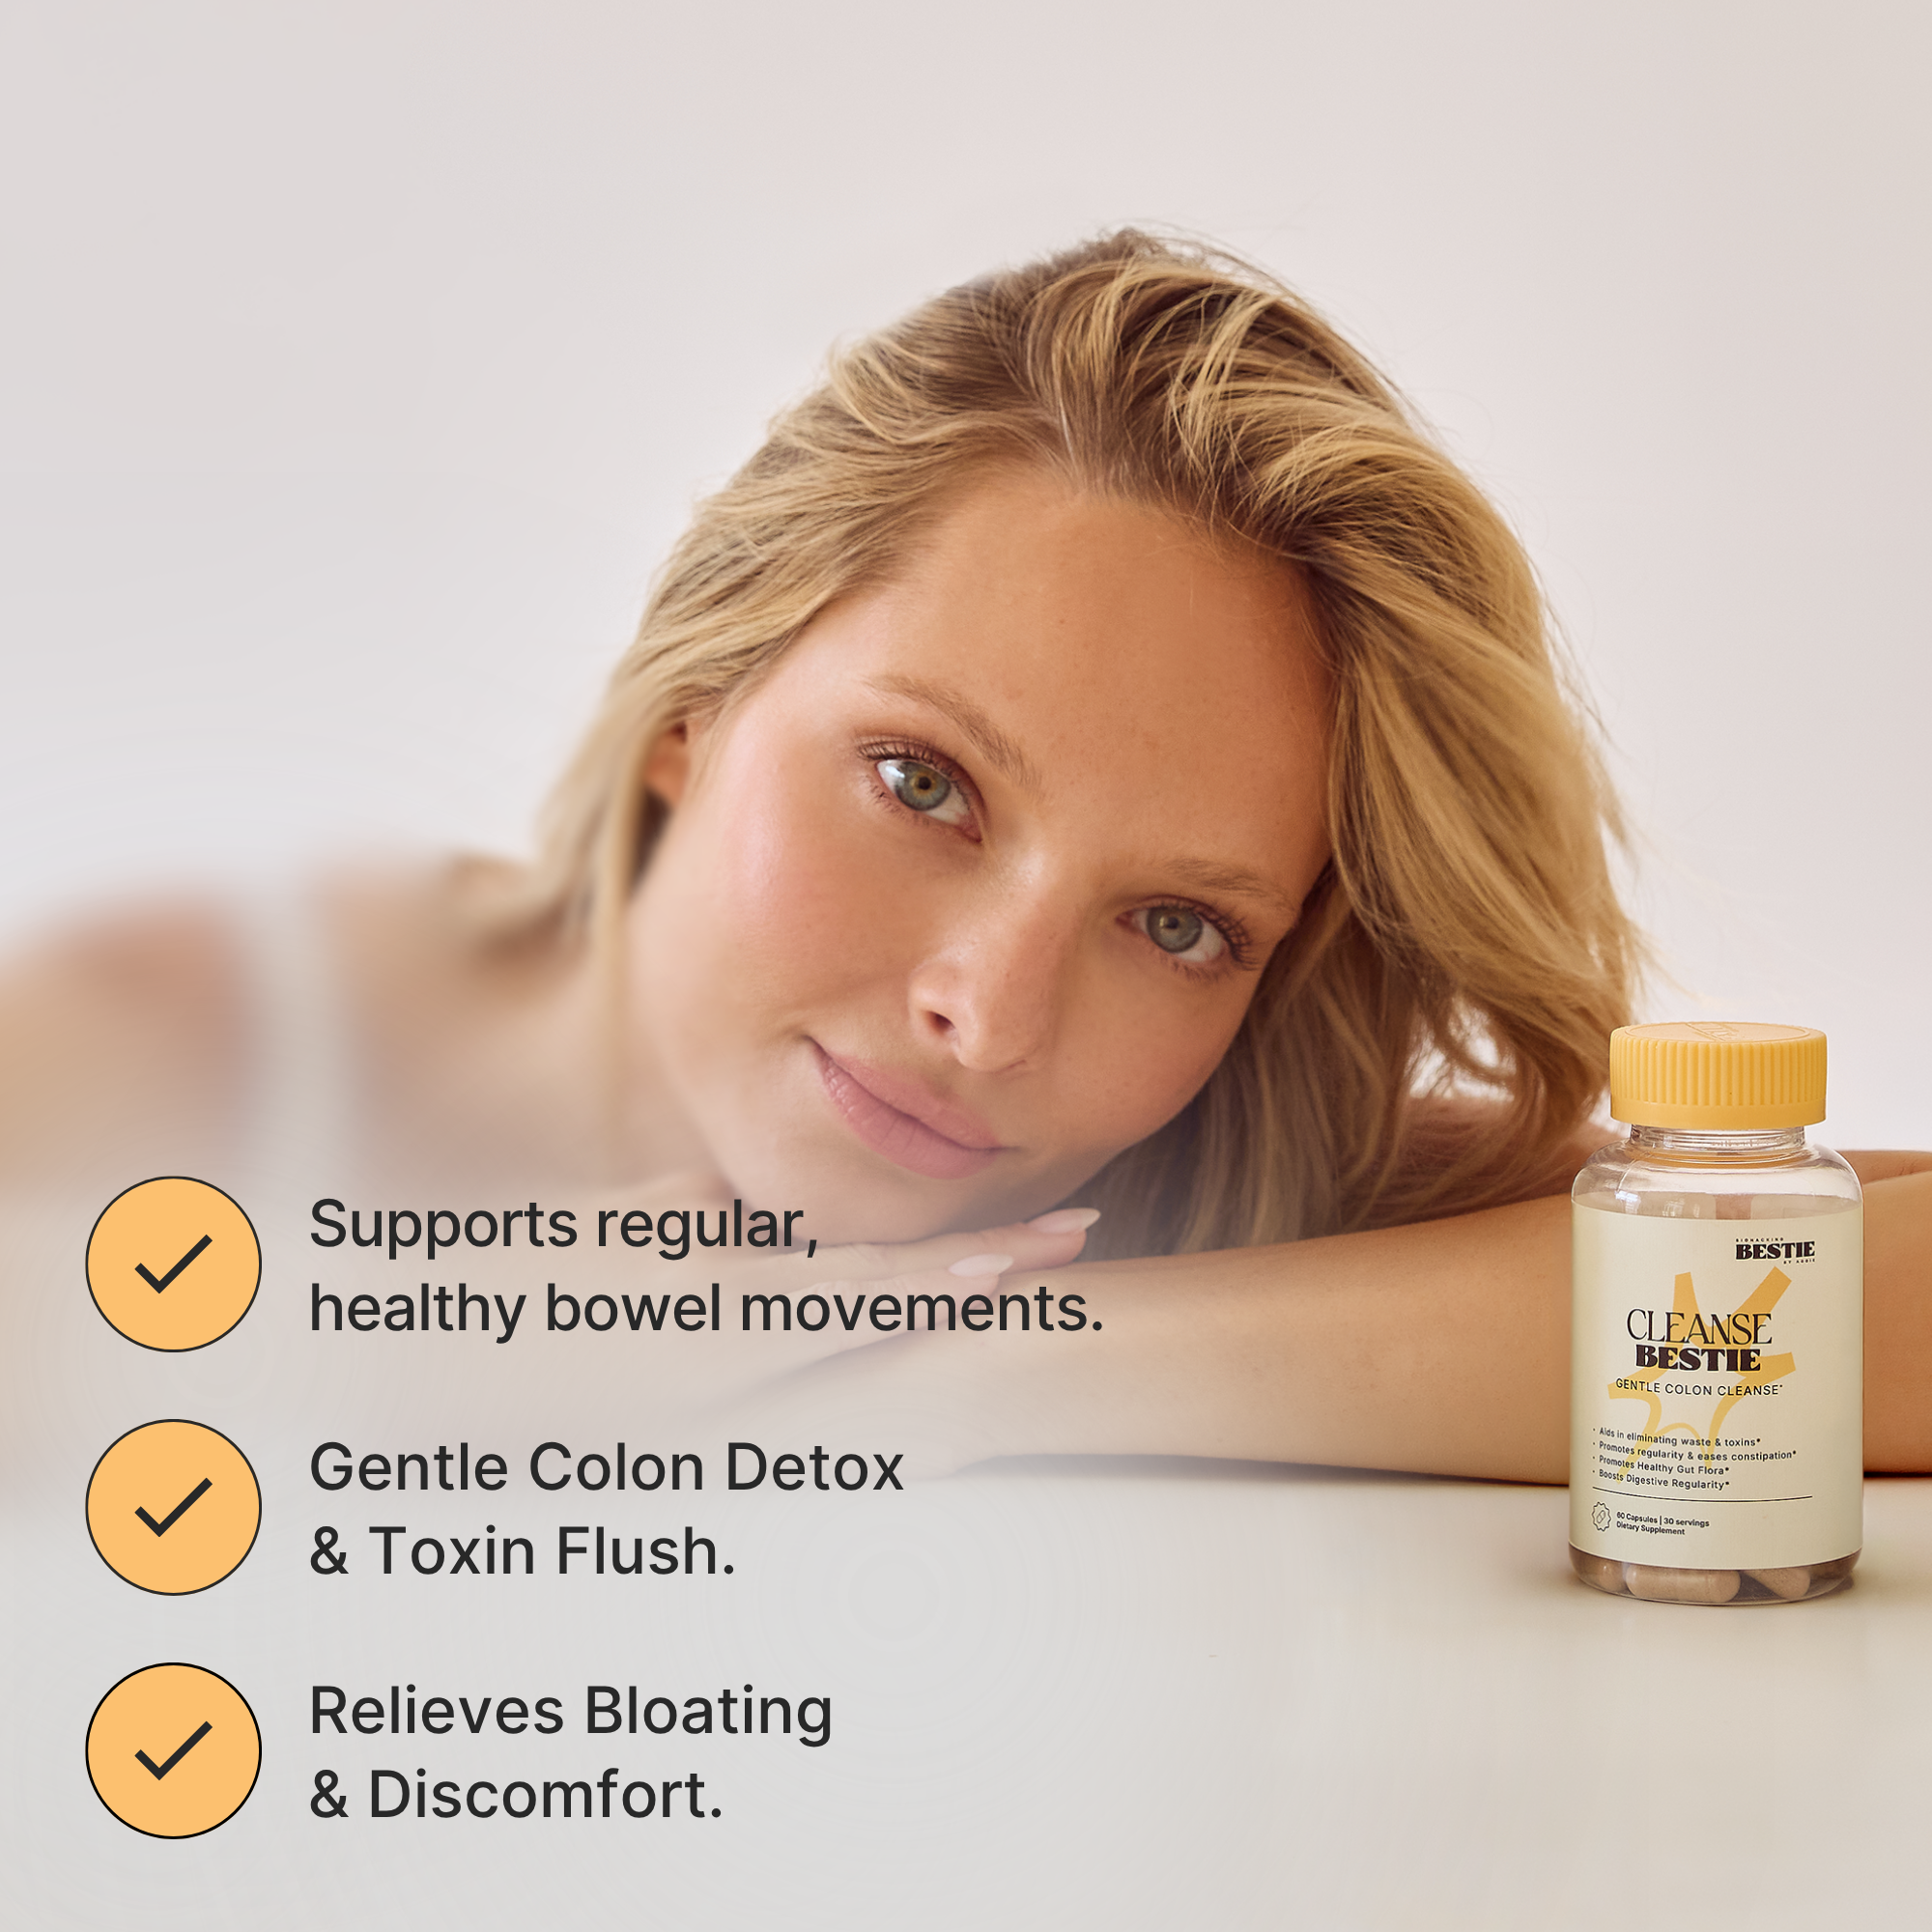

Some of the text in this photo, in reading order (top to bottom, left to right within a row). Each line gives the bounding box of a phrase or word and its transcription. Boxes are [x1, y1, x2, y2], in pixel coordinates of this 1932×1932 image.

[1736, 1241, 1815, 1260] BESTIE
[1627, 1308, 1773, 1345] CLEANSE
[1635, 1344, 1761, 1372] BESTIE
[1615, 1378, 1661, 1393] GENTLE
[1664, 1383, 1712, 1395] COLON
[1599, 1427, 1615, 1437] Aids
[1617, 1430, 1624, 1438] in
[1627, 1433, 1677, 1446] eliminating
[1715, 1437, 1721, 1446] &
[1599, 1440, 1635, 1455] Promotes
[1637, 1448, 1684, 1461] regularity
[1687, 1451, 1693, 1460] &
[1599, 1454, 1635, 1469] Promotes
[1637, 1462, 1674, 1475] Healthy
[1677, 1465, 1694, 1474] Gut
[1599, 1468, 1624, 1482] Boosts
[1626, 1474, 1668, 1487] Digestive
[1616, 1520, 1686, 1535] Dietary Supplement
[1626, 1513, 1658, 1524] Capsules
[1663, 1517, 1674, 1525] 30
[1675, 1519, 1710, 1528] servings
